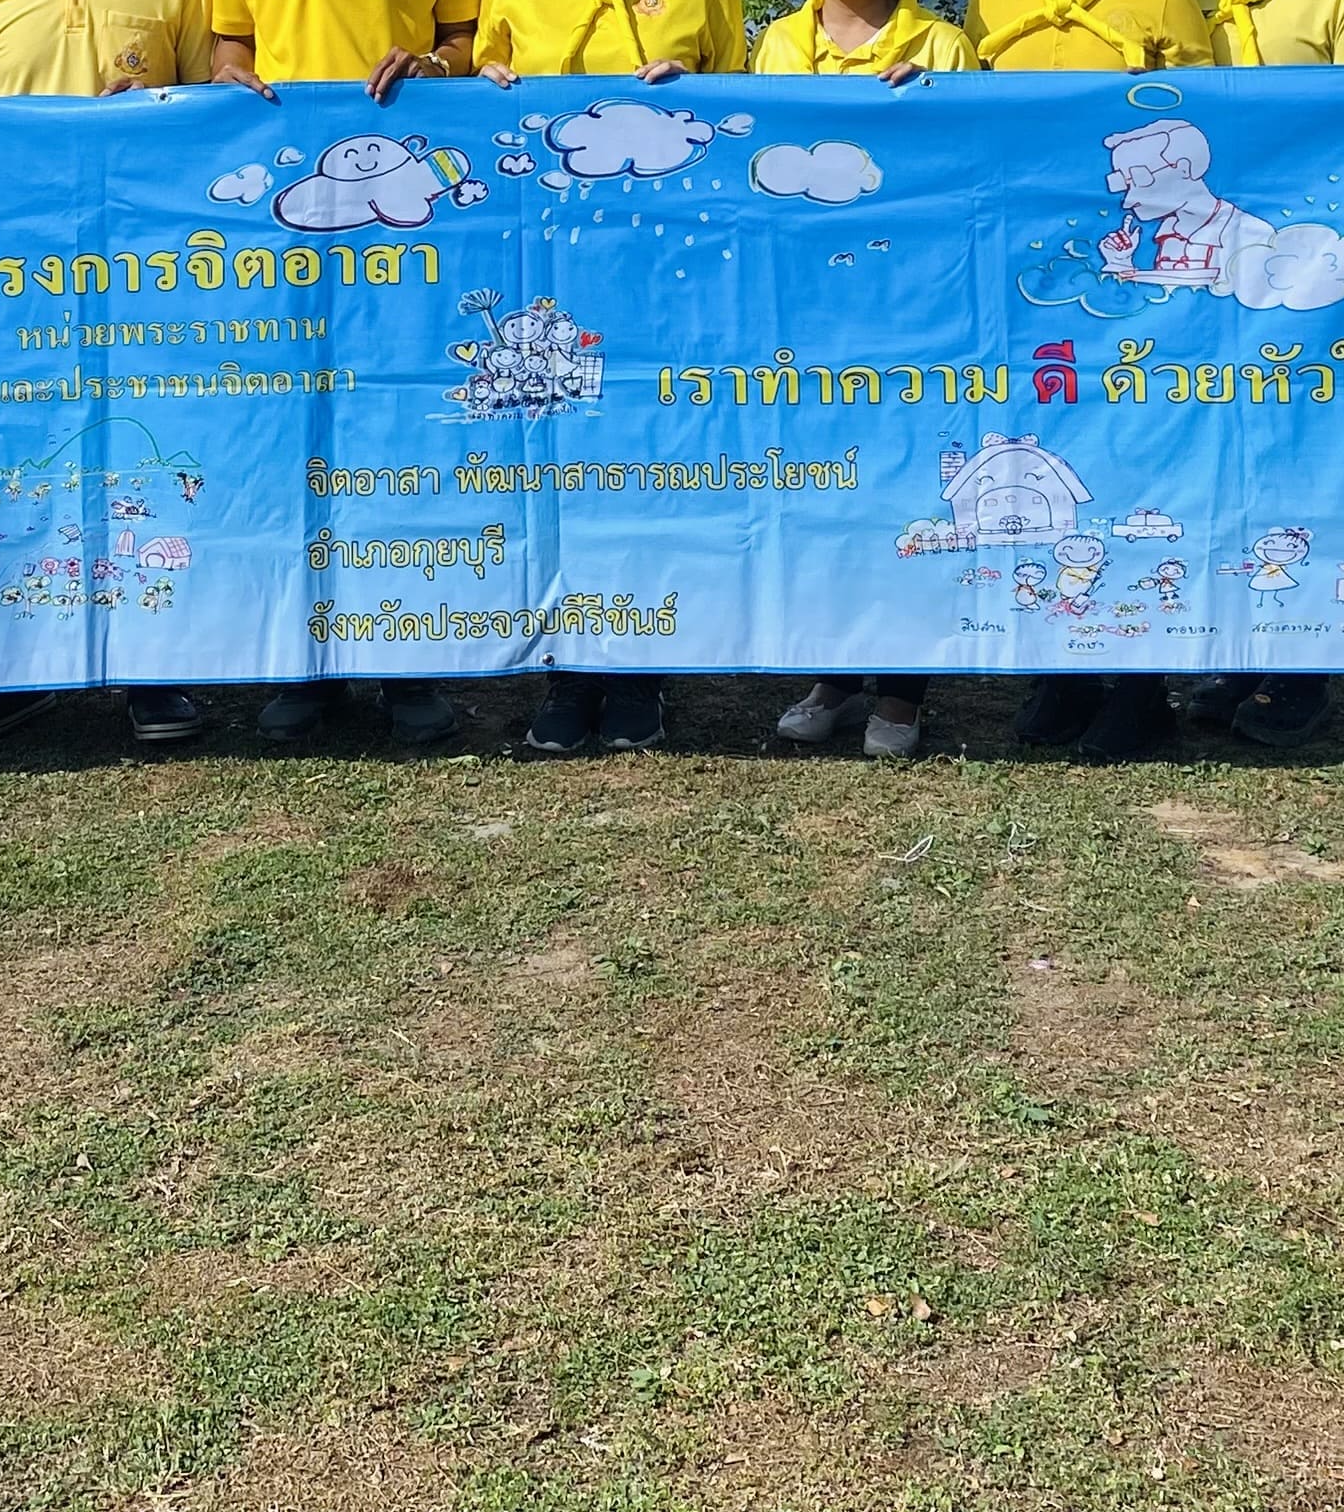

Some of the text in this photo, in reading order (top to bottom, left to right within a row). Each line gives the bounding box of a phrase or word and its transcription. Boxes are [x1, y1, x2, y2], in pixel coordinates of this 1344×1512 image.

[17, 310, 328, 351] หน่วยพระราชทาน
[658, 347, 1011, 405] เราทำความ
[1032, 339, 1078, 405] ดี
[306, 446, 860, 497] จิตอาสา พัฒนาสาธารณประโยชน์
[307, 523, 507, 581] อำเภอกุยบุรี
[307, 592, 678, 644] จังหวัดประจวบคีรีขันธ์
